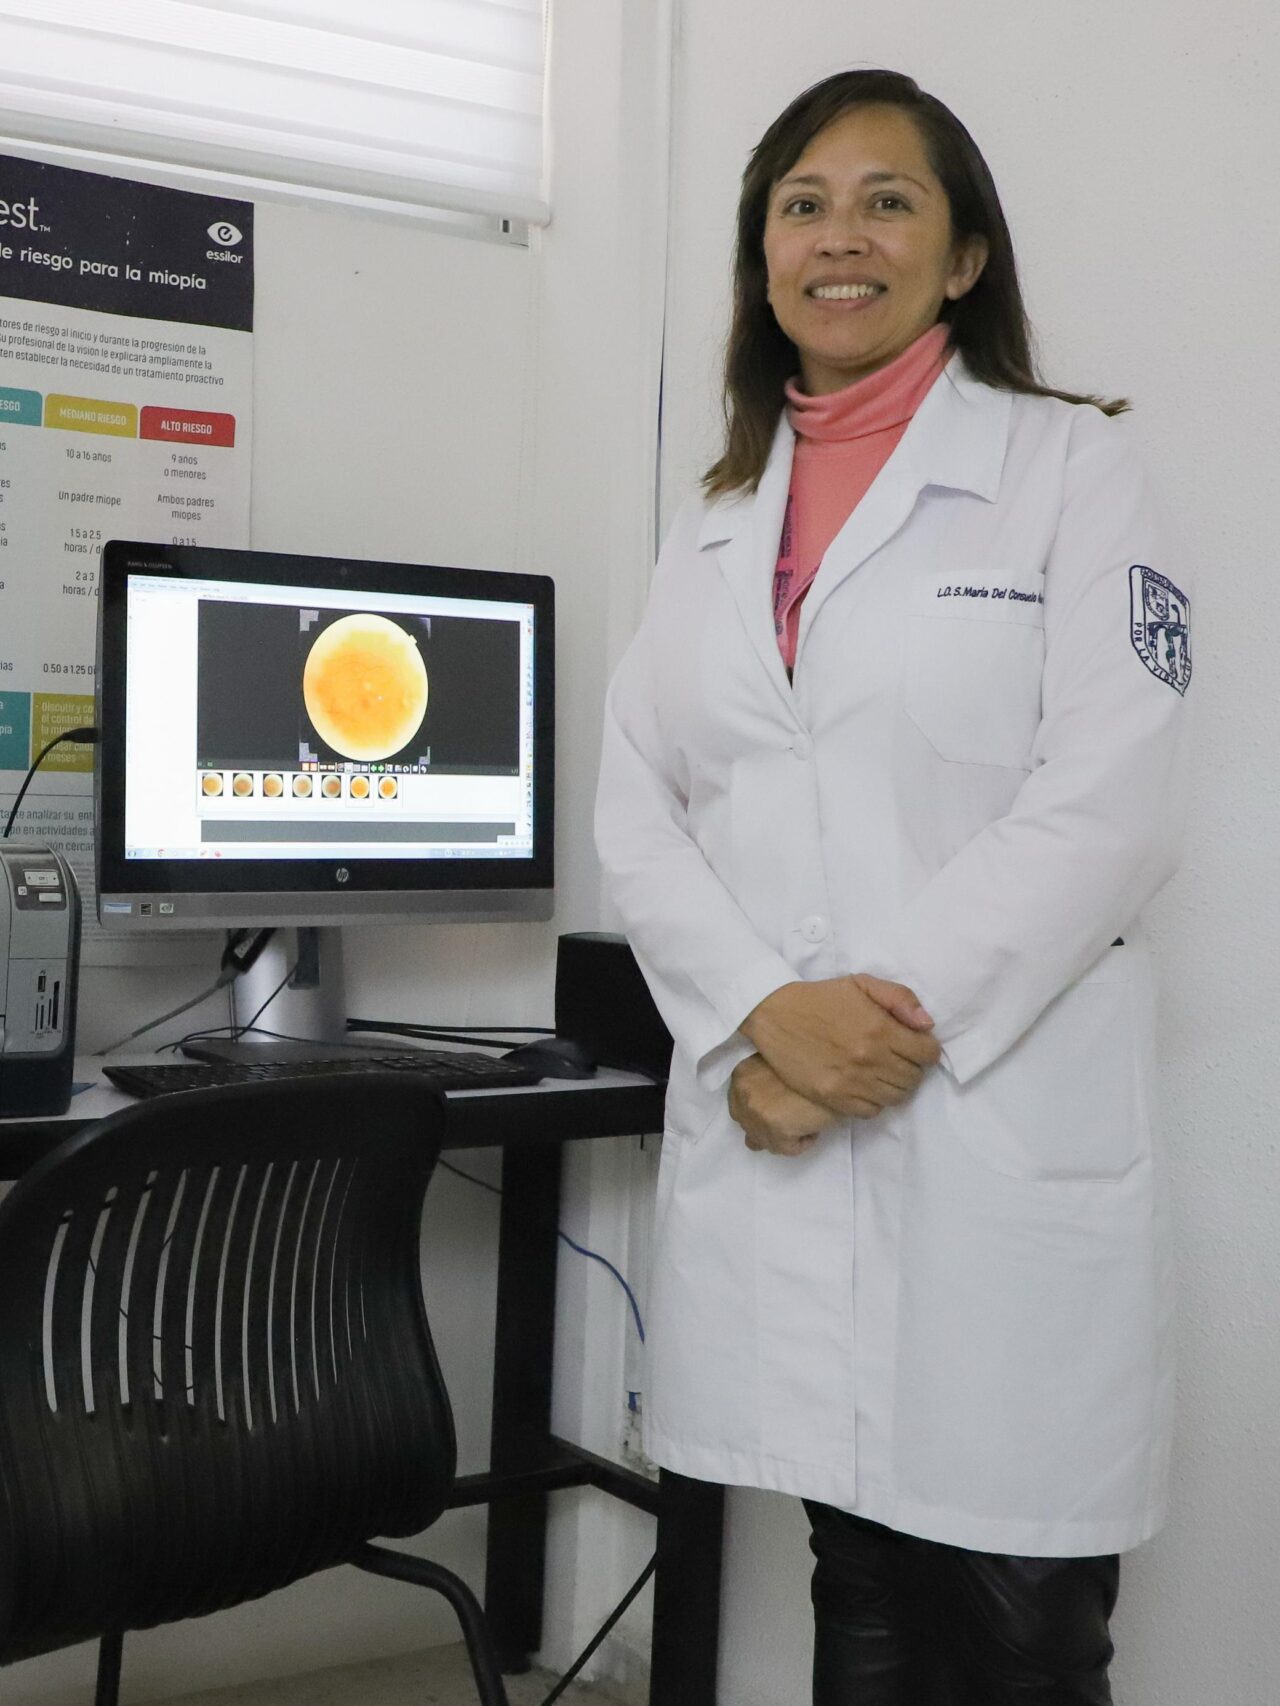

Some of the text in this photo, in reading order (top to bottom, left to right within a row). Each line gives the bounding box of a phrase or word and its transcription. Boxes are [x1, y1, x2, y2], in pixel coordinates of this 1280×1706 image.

[206, 250, 243, 264] essilor
[20, 247, 73, 270] riesgo
[80, 258, 118, 275] para
[125, 261, 141, 278] la
[149, 267, 206, 288] miopía
[22, 320, 33, 332] de
[35, 323, 60, 338] riesgo
[61, 326, 68, 337] al
[70, 327, 91, 341] inicio
[93, 333, 98, 344] y
[99, 331, 129, 345] durante
[131, 335, 139, 347] la
[186, 342, 197, 354] de
[198, 344, 206, 355] la
[8, 335, 54, 350] profesional
[56, 340, 66, 352] de
[68, 342, 75, 353] la
[101, 346, 108, 358] le
[148, 354, 203, 369] ampliamente
[204, 359, 212, 370] la
[15, 349, 59, 365] establecer
[60, 354, 68, 366] la
[69, 358, 110, 371] necesidad
[111, 361, 121, 373] de
[123, 365, 133, 374] un
[135, 364, 183, 380] tratamiento
[185, 372, 223, 385] proactivo
[59, 407, 127, 425] MEDIANO RIESGO
[161, 420, 212, 435] ALTO RIESGO
[66, 448, 91, 460] 10 a 16
[171, 453, 176, 464] 9
[164, 469, 206, 480] o menores
[58, 490, 121, 508] Un padre miope
[157, 494, 214, 508] Ambos padres
[171, 509, 201, 522] miopes
[82, 531, 87, 539] a
[64, 541, 93, 556] horas /
[75, 570, 94, 582] 2 a 3
[62, 583, 92, 598] horas /
[991, 588, 1007, 599] Del
